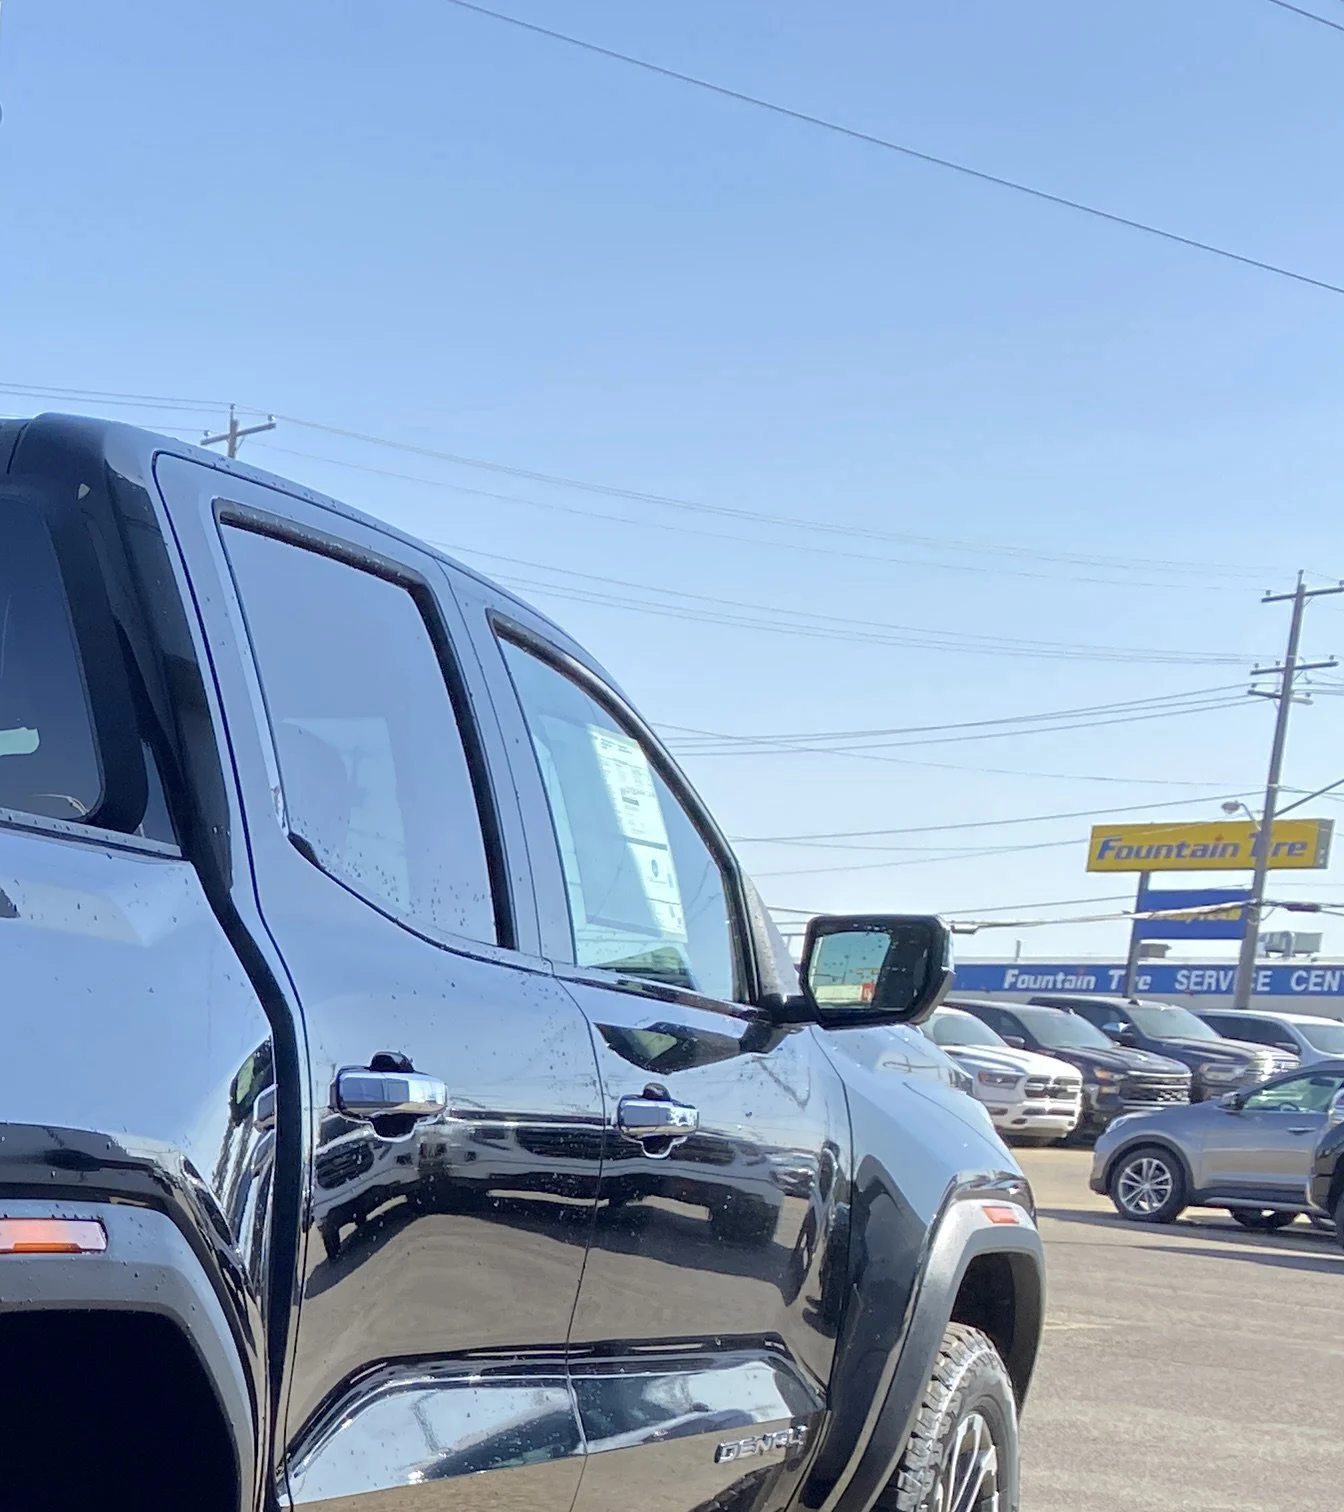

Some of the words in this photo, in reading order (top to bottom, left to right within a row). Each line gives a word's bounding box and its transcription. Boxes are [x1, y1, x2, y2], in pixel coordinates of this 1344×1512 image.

[1096, 834, 1240, 860] Fountain
[1248, 831, 1308, 857] Tre
[1003, 968, 1096, 990] Fountain
[1174, 969, 1273, 992] SERVE
[1290, 969, 1344, 992] CEN
